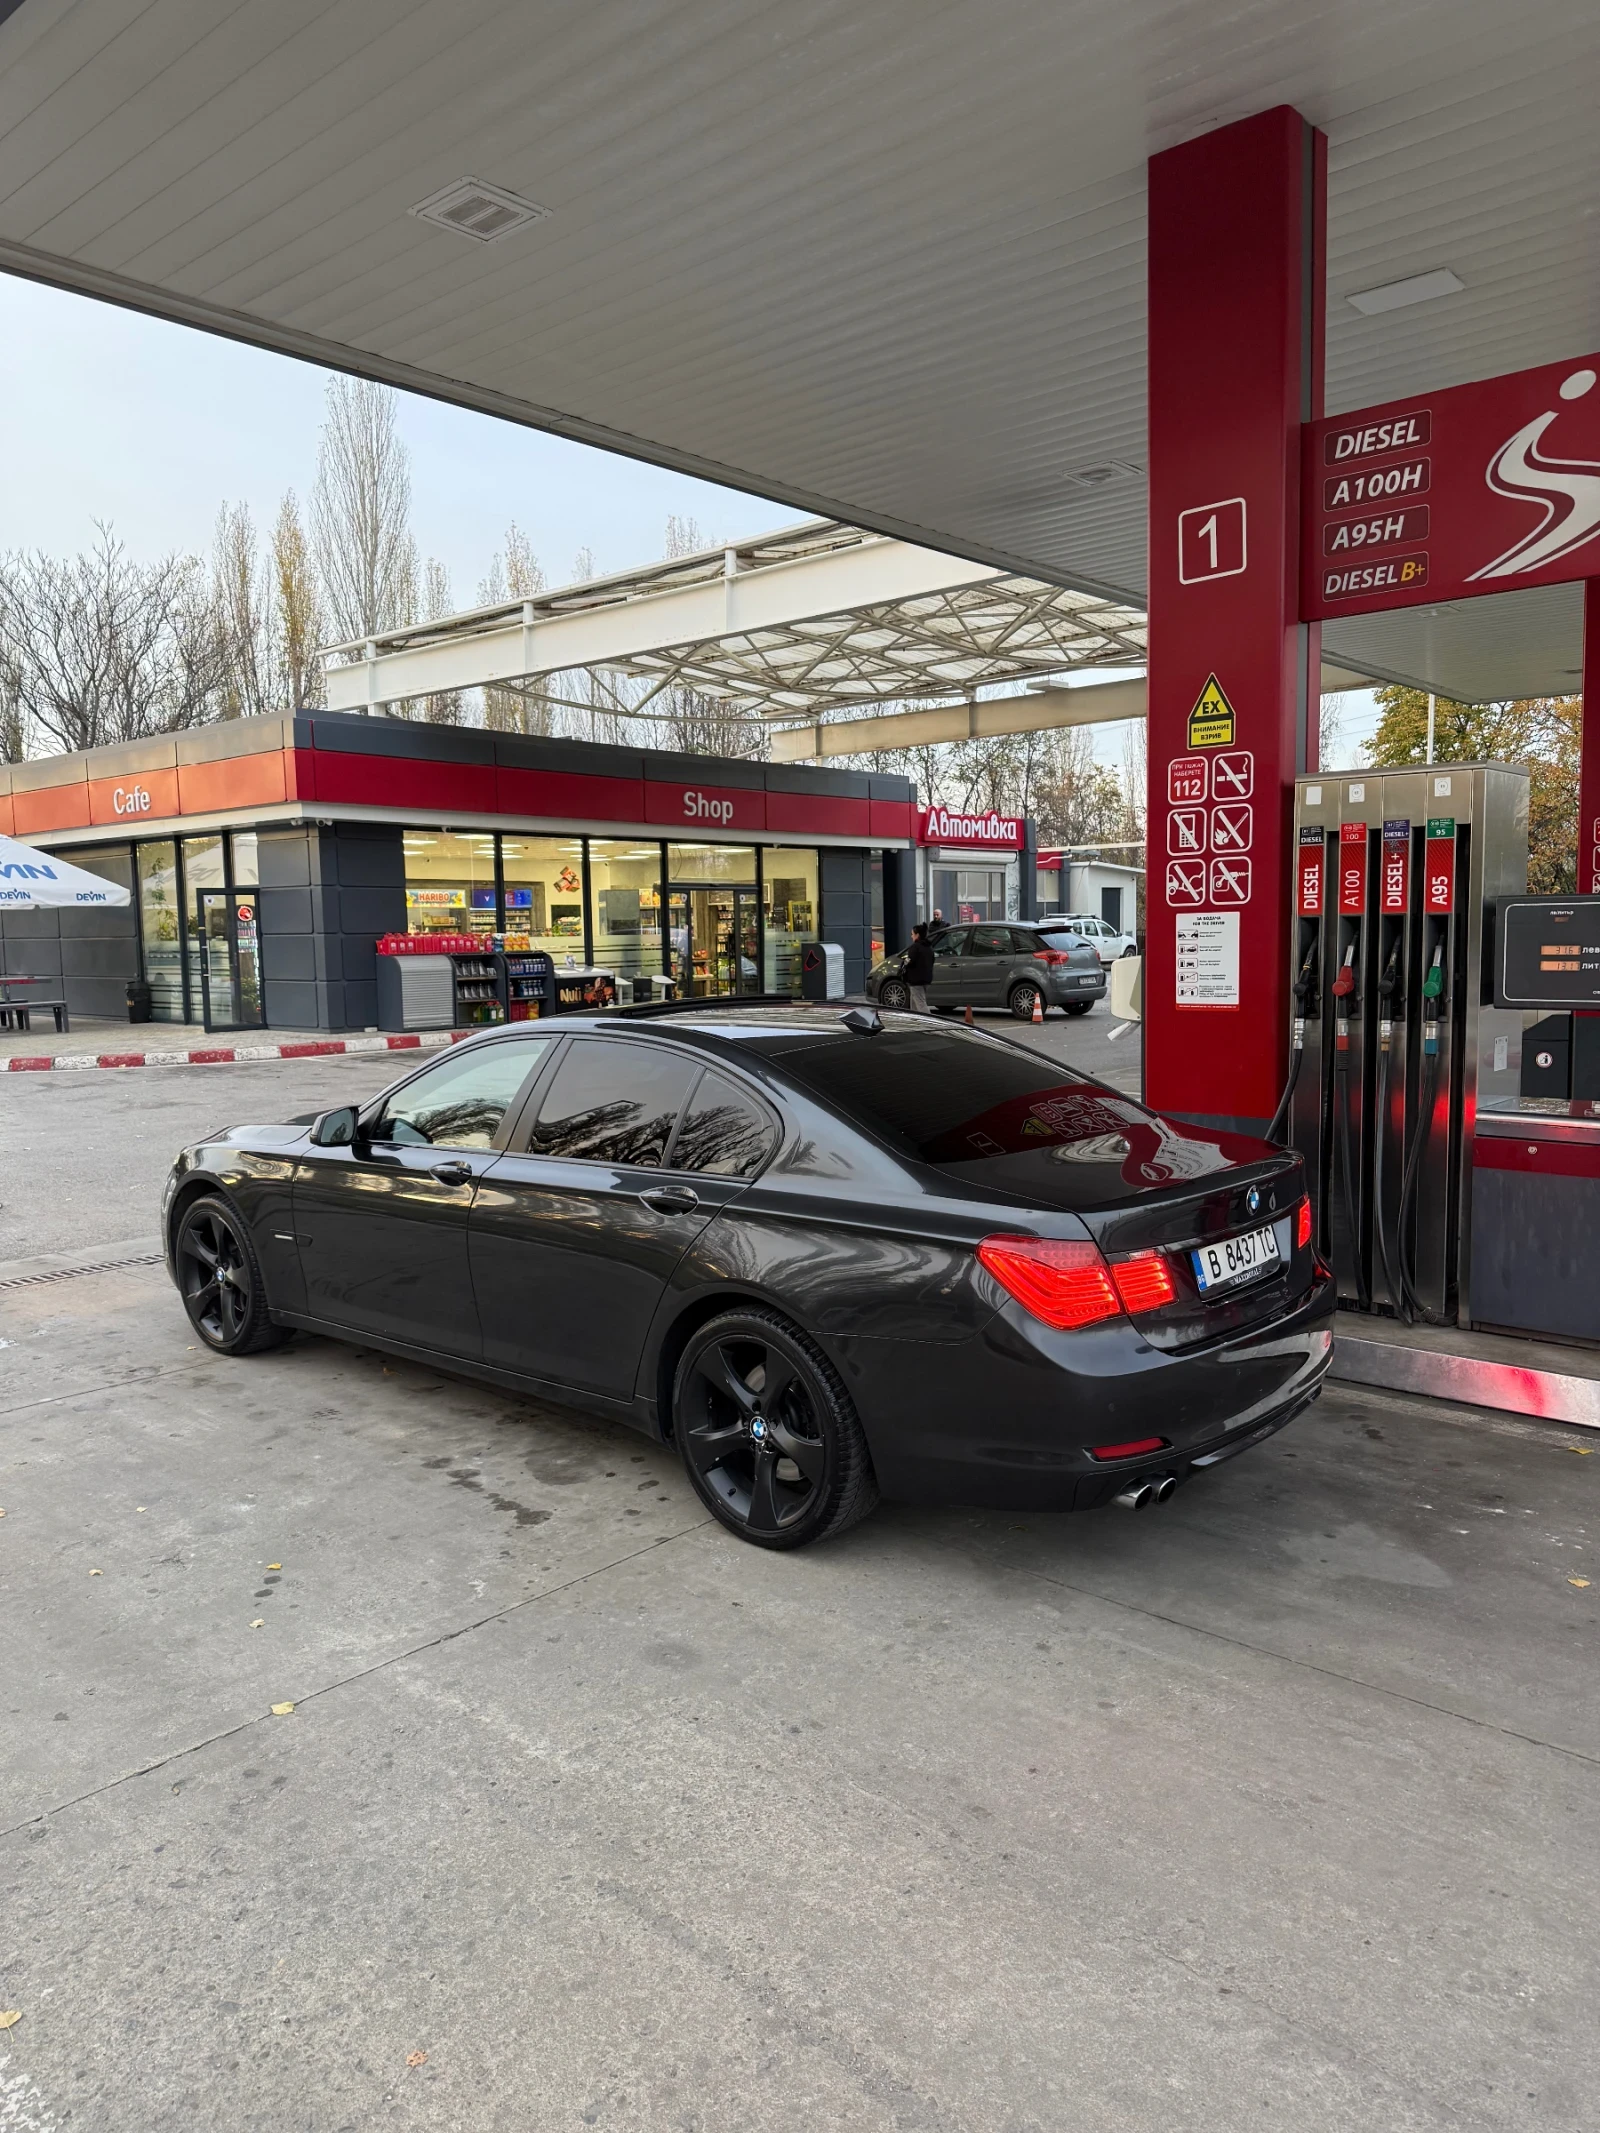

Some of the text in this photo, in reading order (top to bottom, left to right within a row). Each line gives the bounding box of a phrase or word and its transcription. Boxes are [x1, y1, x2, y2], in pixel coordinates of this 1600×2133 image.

[1335, 419, 1420, 459] DIESEL
[1331, 464, 1422, 506] A100H
[1198, 514, 1218, 569] 1
[1331, 515, 1405, 551] A95H
[1325, 561, 1426, 595] DIESEL B+
[1202, 700, 1221, 714] EX
[1193, 723, 1230, 734] ВНИМАНИЕ
[1200, 732, 1222, 741] ВЗРИВ
[1173, 779, 1201, 797] 112
[683, 791, 734, 825] Shop
[927, 810, 1018, 840] Автомивка
[1346, 833, 1360, 841] 100
[1436, 828, 1446, 836] 95
[1300, 836, 1323, 844] DIESEL
[0, 888, 31, 900] DEVIN
[76, 890, 107, 902] DEVIN
[418, 891, 450, 902] HARIBO
[1303, 864, 1320, 909] DIESEL
[1344, 869, 1361, 907] A100
[1431, 875, 1449, 906] A95
[1582, 963, 1600, 971] лит
[1208, 1249, 1221, 1279] B
[1225, 1233, 1257, 1272] 8437
[1256, 1227, 1275, 1257] TC
